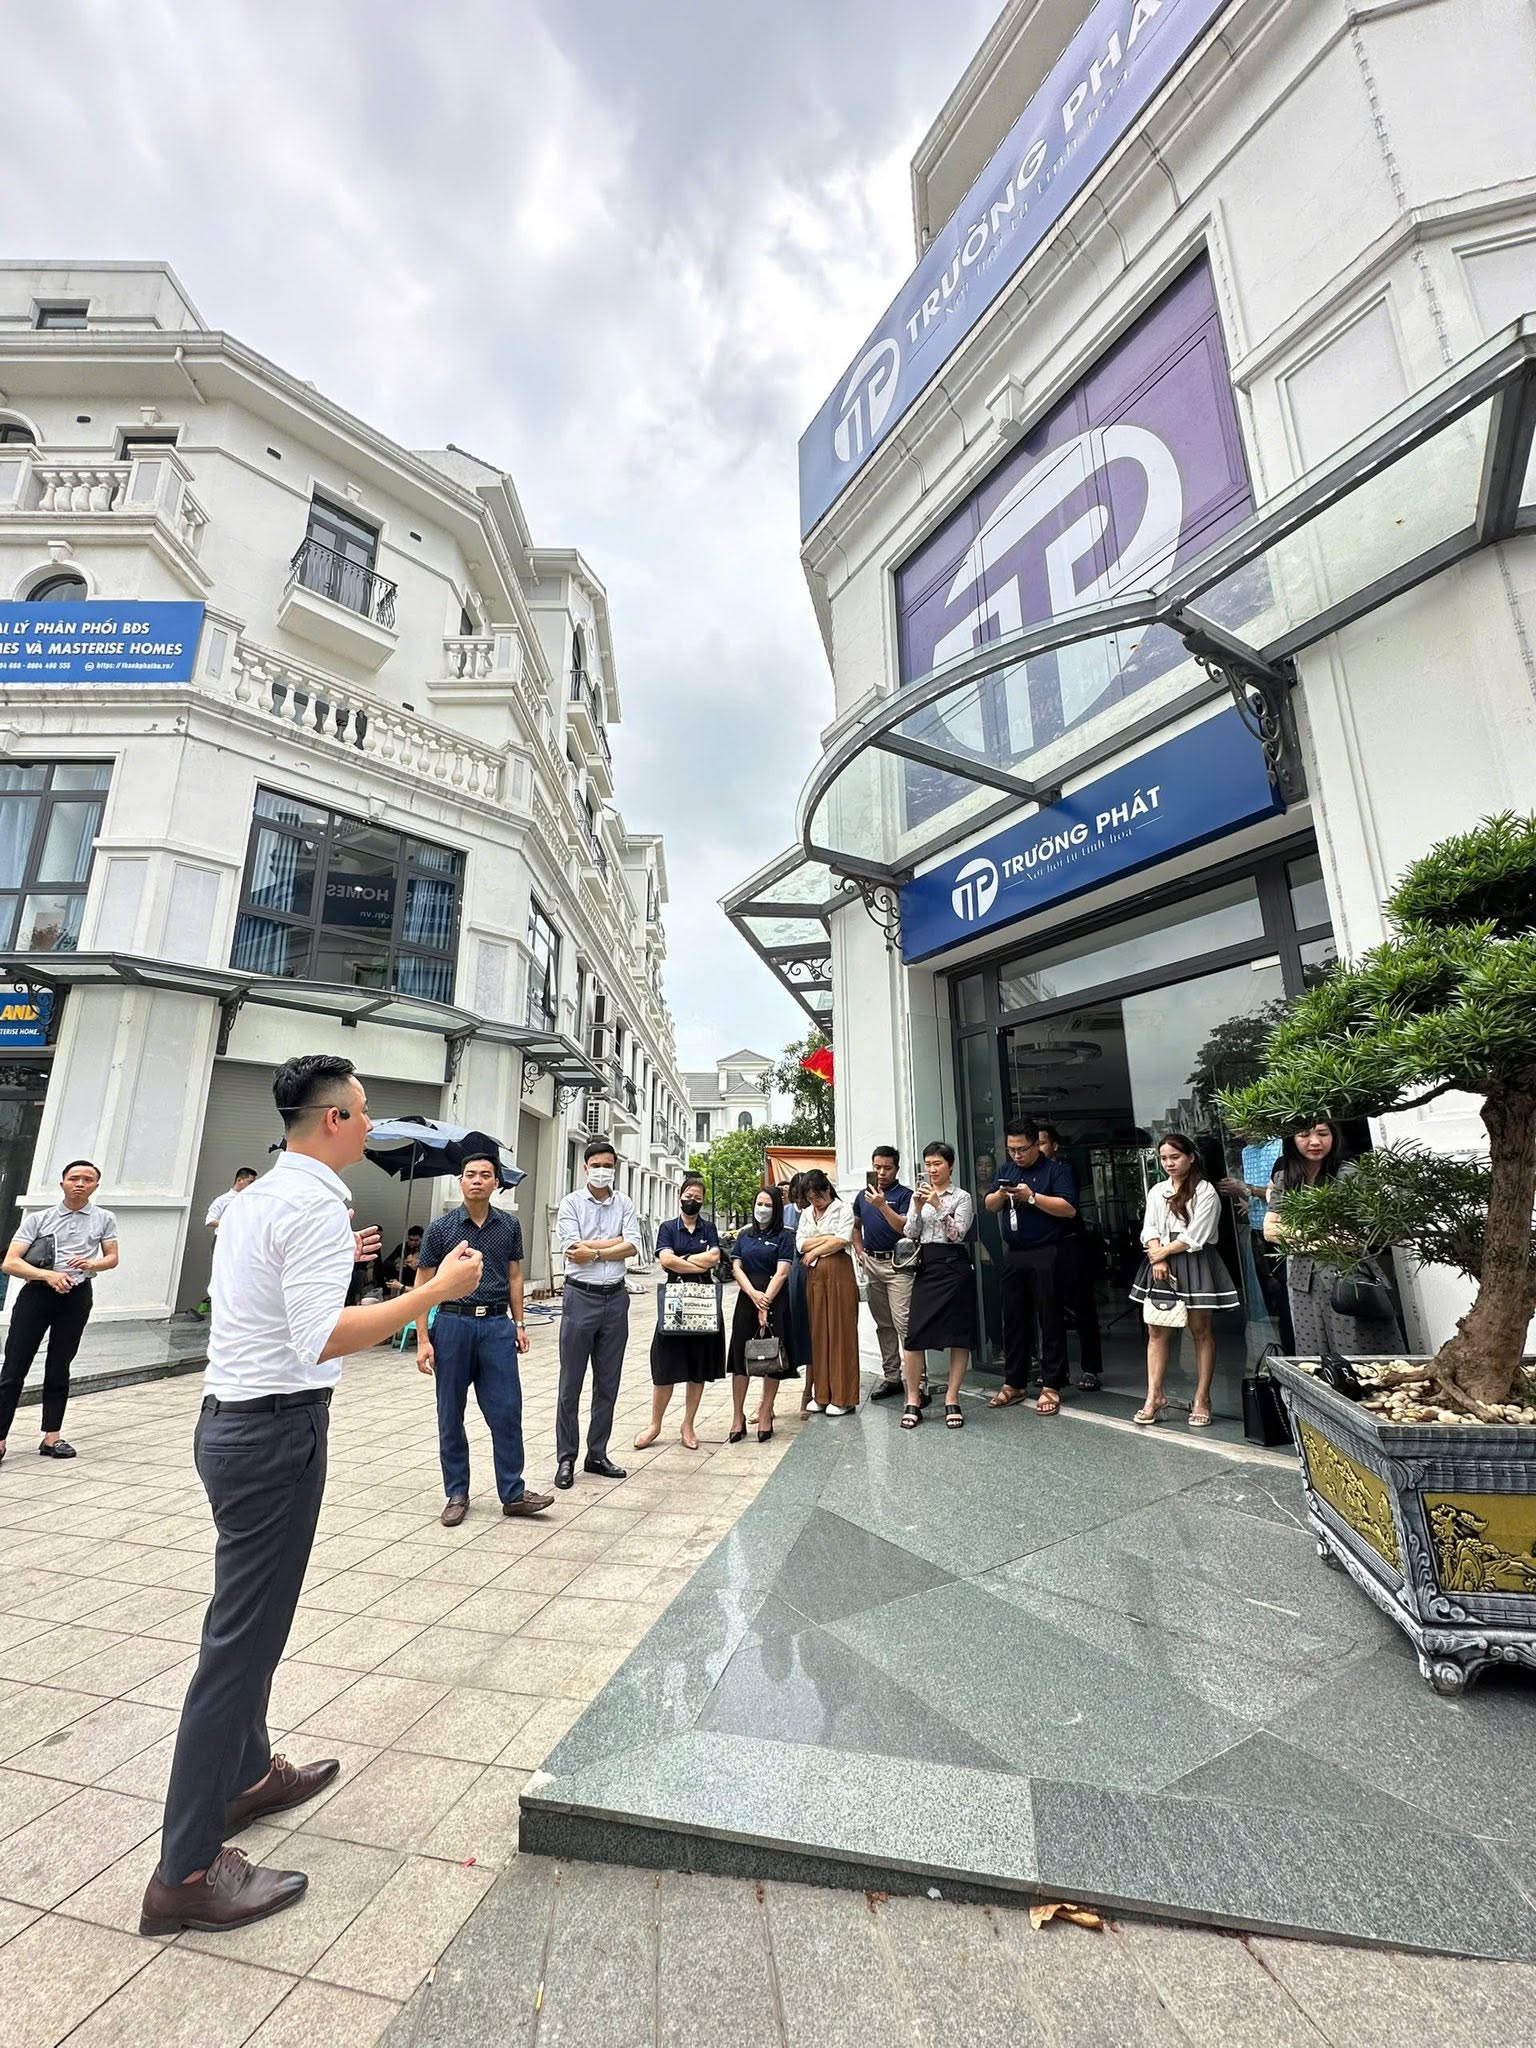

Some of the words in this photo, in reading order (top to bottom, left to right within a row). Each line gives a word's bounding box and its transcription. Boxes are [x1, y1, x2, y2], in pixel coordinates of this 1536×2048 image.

[906, 138, 1048, 343] TRƯỜNG
[13, 619, 31, 634] LÝ
[34, 620, 77, 634] PHÂN
[81, 618, 118, 634] PHỐI
[122, 622, 150, 634] BĐS
[25, 640, 43, 655] VÀ
[47, 642, 125, 655] MASTERISE
[129, 642, 183, 656] HOMES
[1001, 823, 1089, 879] TRƯỜNG
[1095, 785, 1161, 834] PHÁT
